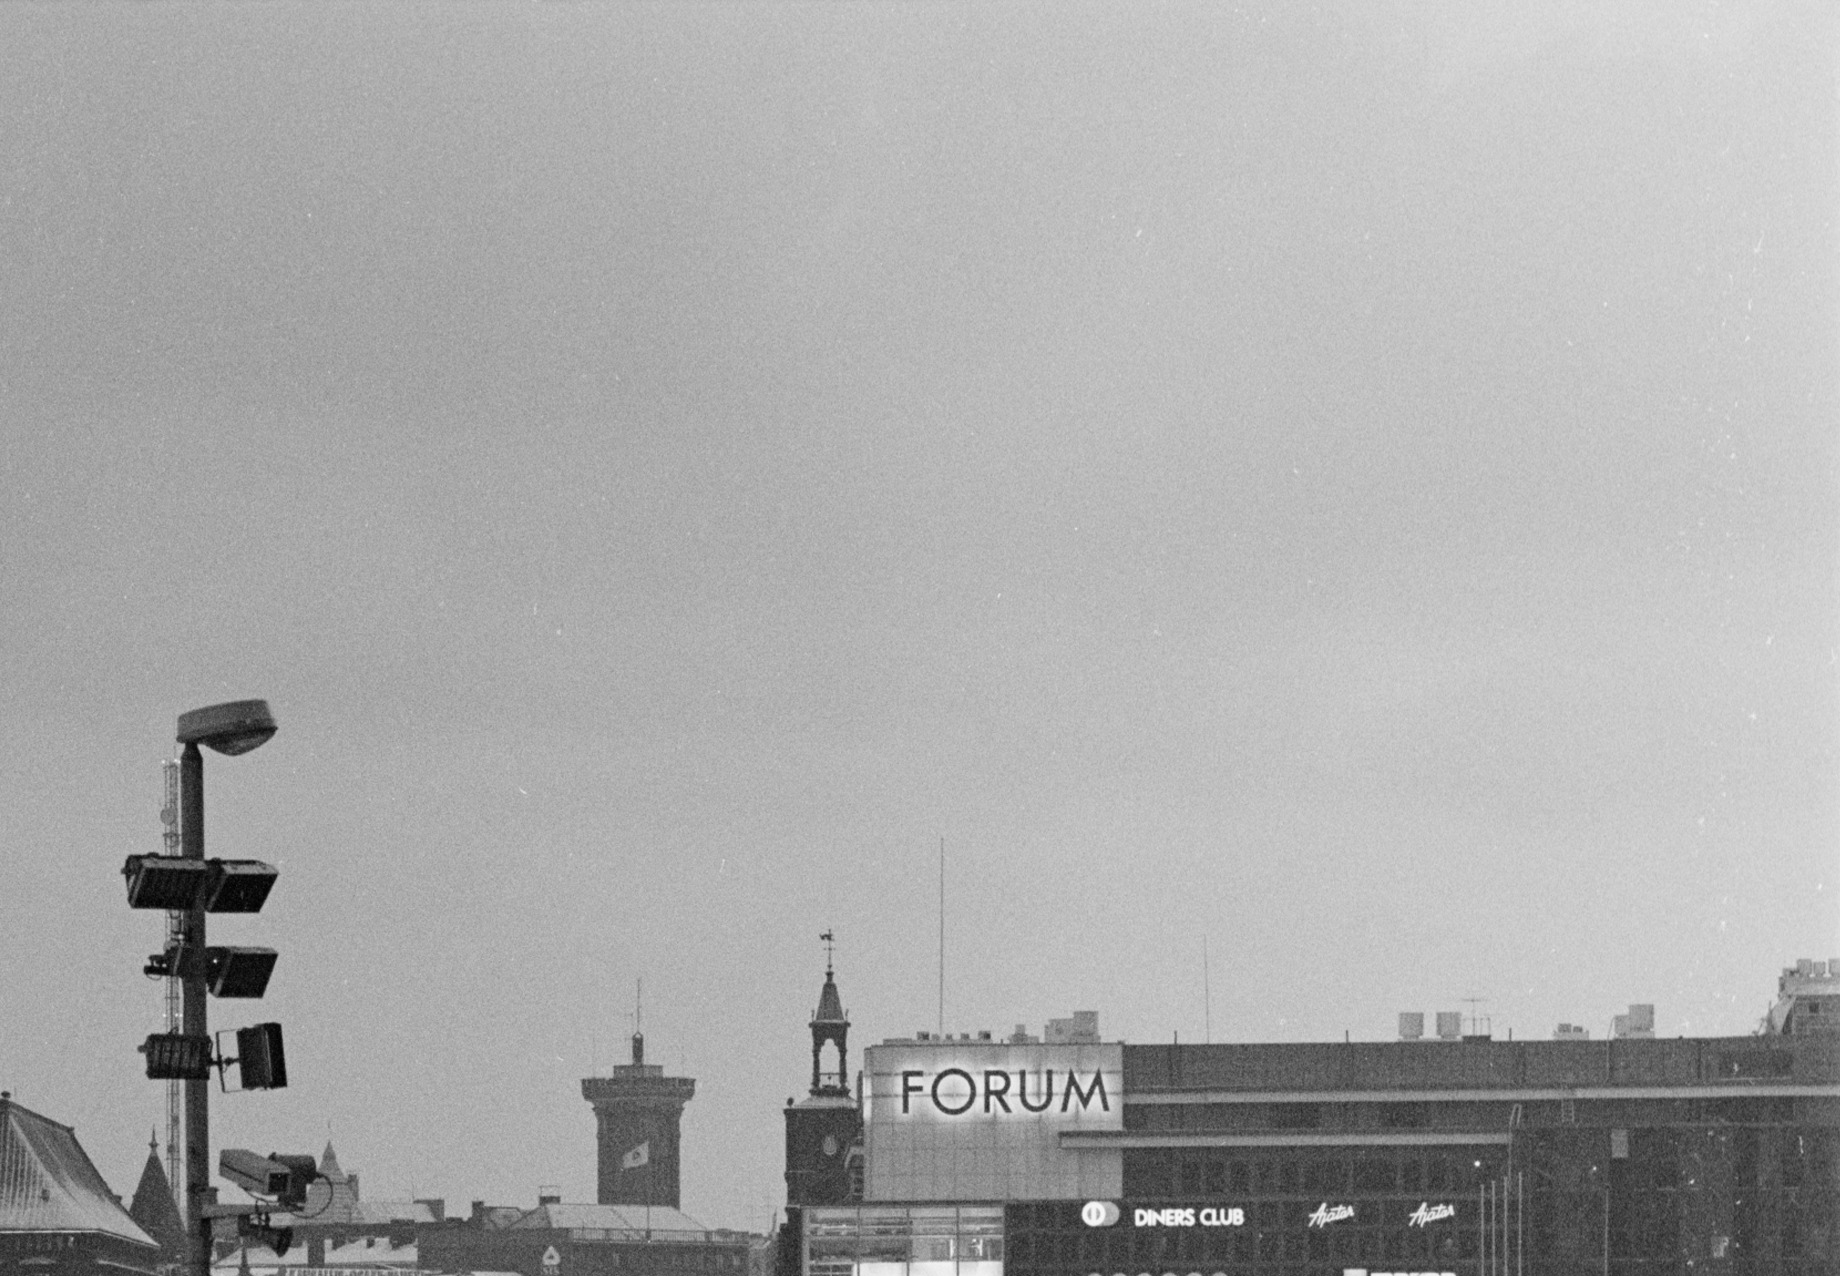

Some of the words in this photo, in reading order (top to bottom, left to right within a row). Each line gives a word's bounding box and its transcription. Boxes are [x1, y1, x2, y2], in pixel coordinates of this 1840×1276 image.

[901, 1068, 1111, 1116] FORUM
[1134, 1208, 1196, 1227] DINERS
[1199, 1207, 1245, 1227] CLUB
